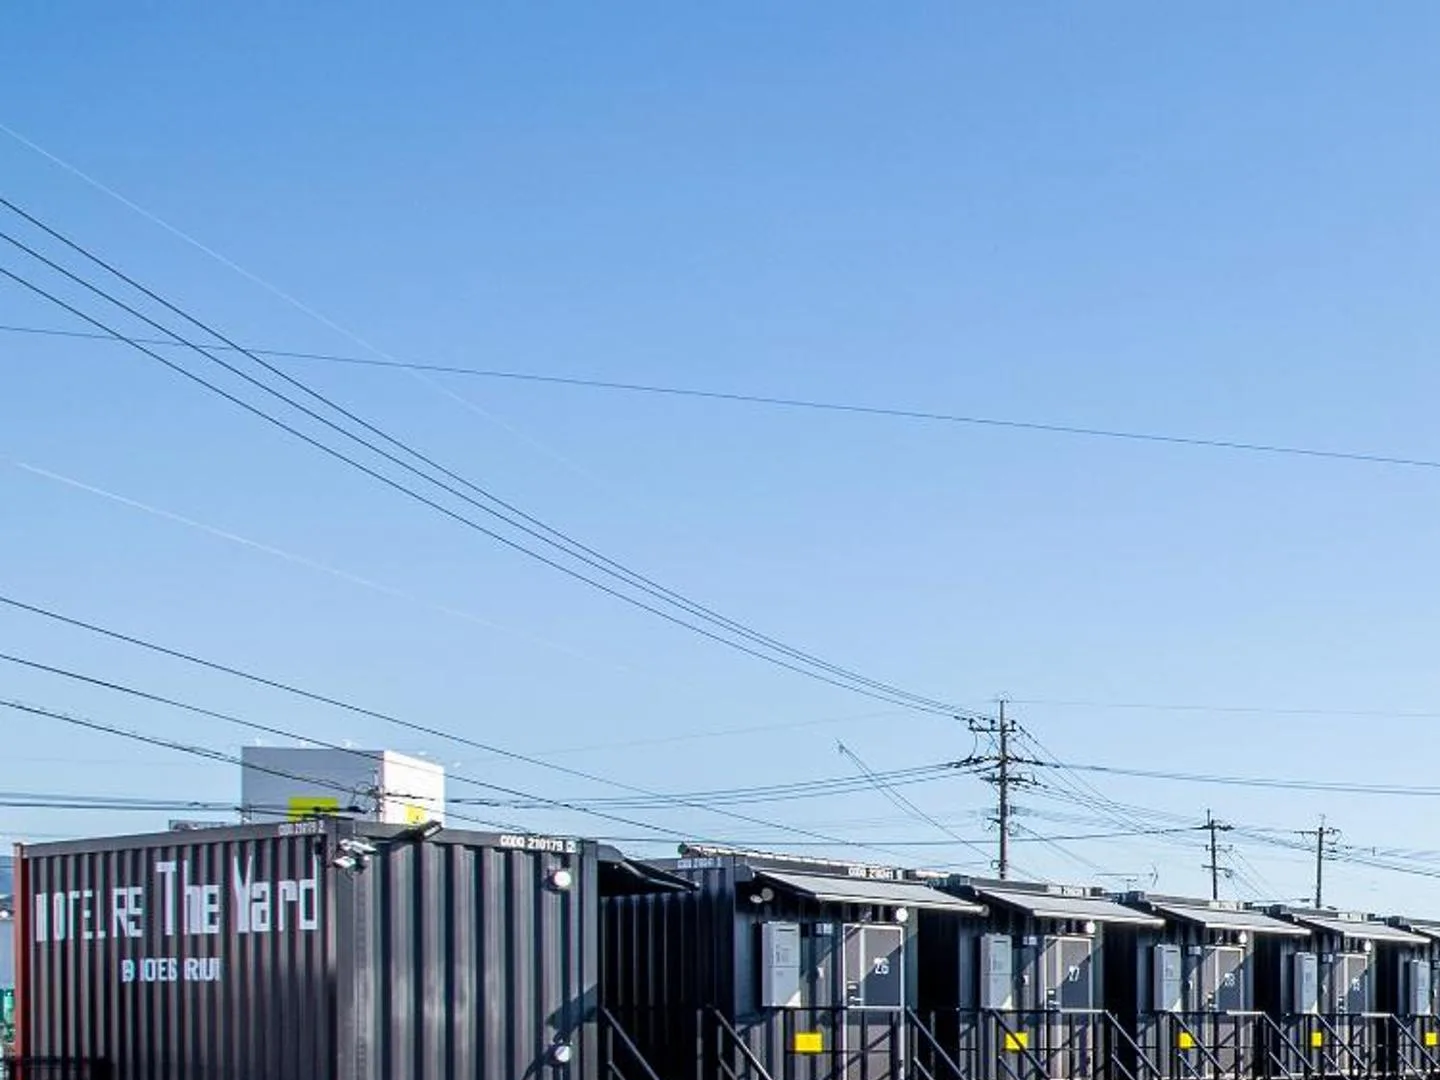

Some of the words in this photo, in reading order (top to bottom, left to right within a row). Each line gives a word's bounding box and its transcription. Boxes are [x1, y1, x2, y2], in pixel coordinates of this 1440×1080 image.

[156, 860, 220, 936] The
[233, 855, 318, 933] Yard
[874, 957, 889, 975] 26
